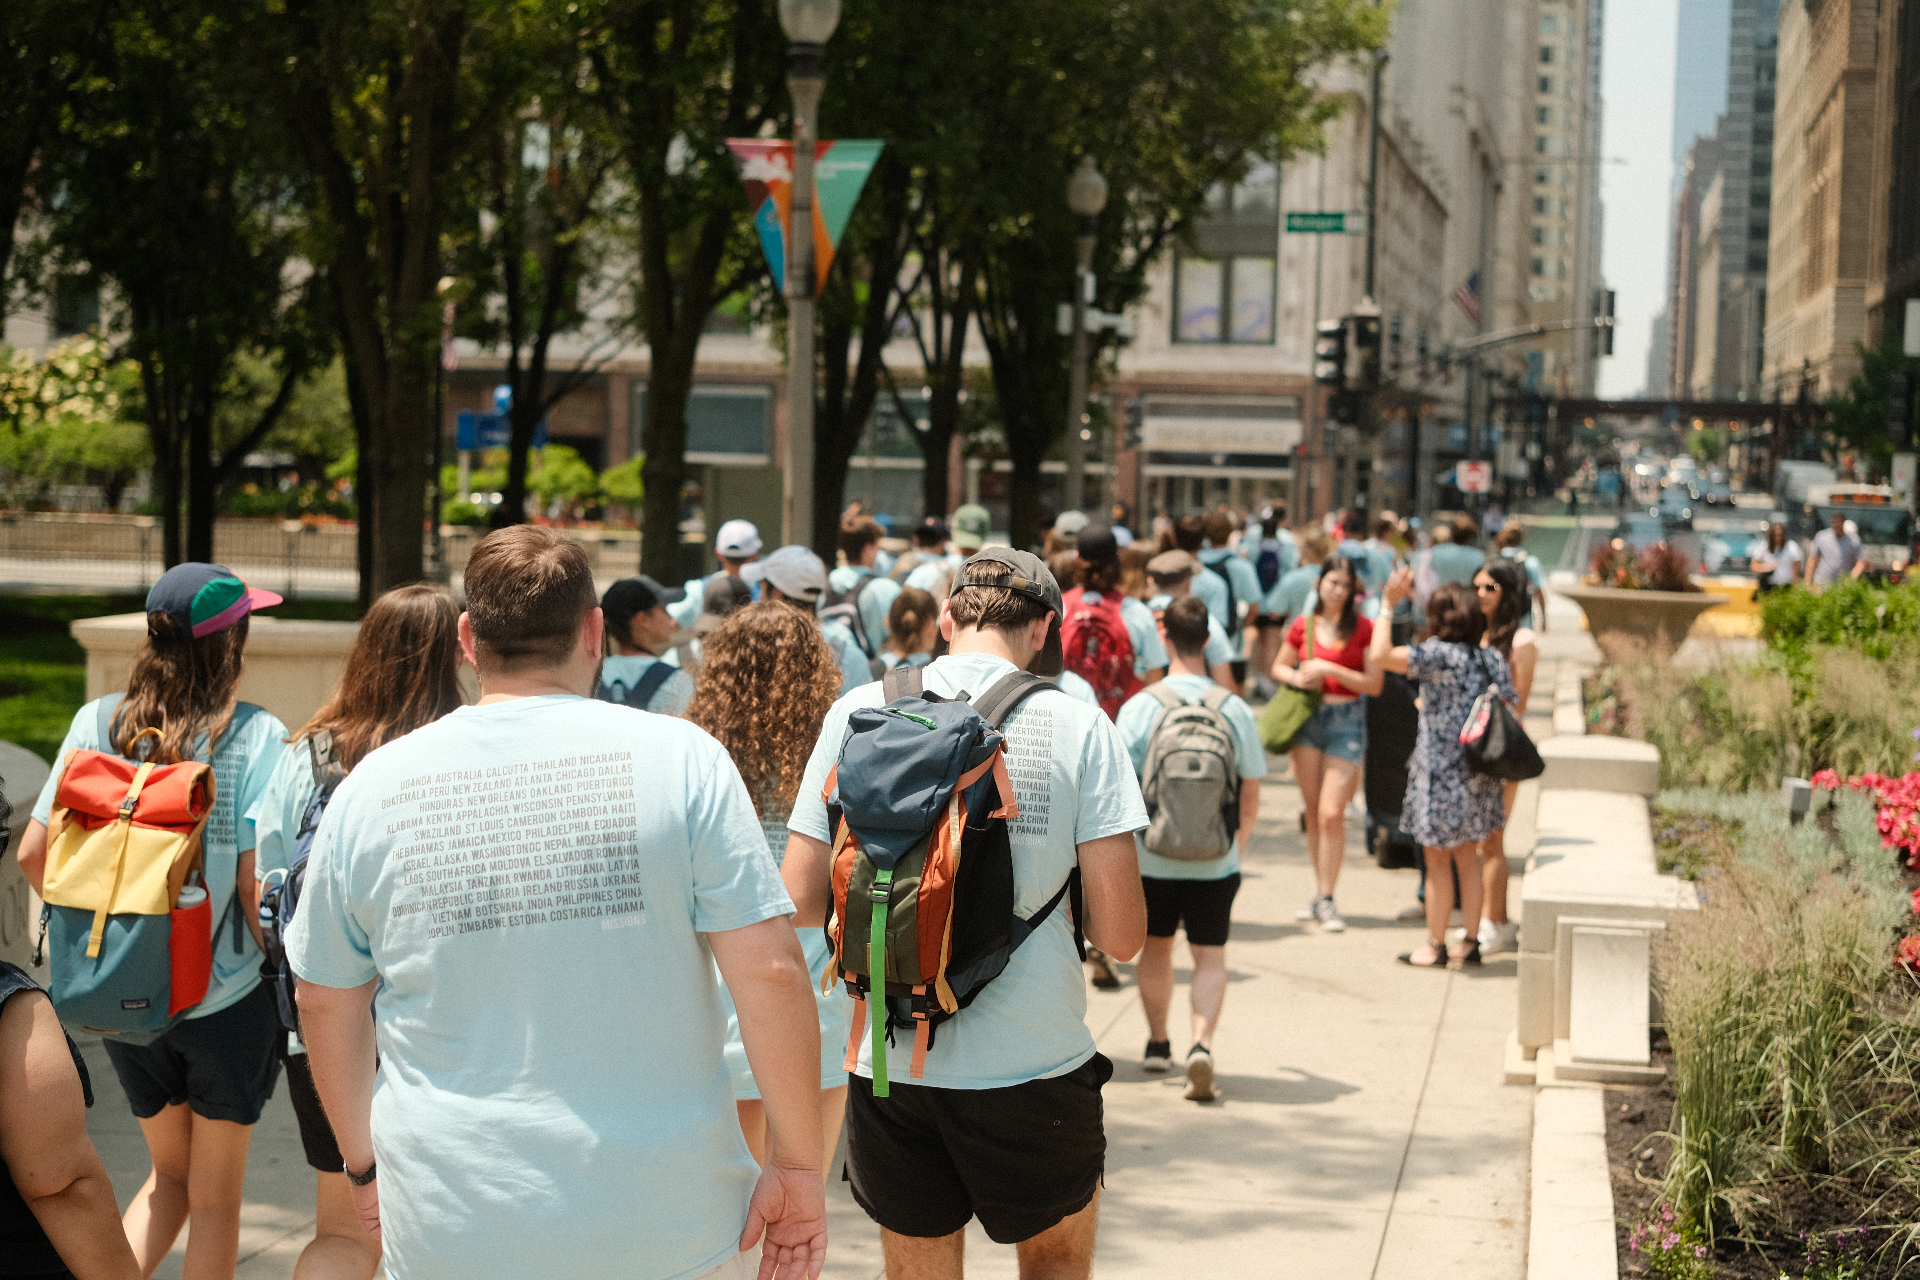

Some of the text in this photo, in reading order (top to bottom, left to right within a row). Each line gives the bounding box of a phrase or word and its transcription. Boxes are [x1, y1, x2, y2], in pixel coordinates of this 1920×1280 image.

[1012, 707, 1052, 718] NICARAGUA
[1025, 717, 1052, 728] DALLAS
[1017, 759, 1051, 770] ECUADOR
[1032, 749, 1052, 759] HAITI
[401, 751, 632, 790] UGANDA AUSTRALIA CALCUTTA THAILAND NICARAGUA
[1007, 769, 1051, 781] OZAMBIQUE
[381, 789, 426, 809] GUATEMALA
[429, 785, 450, 798] PERU
[515, 773, 553, 787] ATLANTA
[556, 767, 595, 781] CHICAGO
[598, 763, 633, 776] DALLAS
[1016, 780, 1051, 792] ROMANIA
[420, 797, 464, 812] HONDURAS
[530, 783, 572, 798] OAKLAND
[1018, 803, 1050, 814] UKRAINE
[1024, 792, 1051, 803] LATVIA
[387, 789, 634, 835] ALABAMA KENYA APPALACHIA WISCONSIN PENNSYLVANIA
[414, 825, 461, 841] SWAZILAND
[507, 812, 557, 828] CAMEROON
[560, 805, 608, 820] CAMBODIA
[611, 802, 636, 814] HAITI
[1026, 814, 1049, 825] CHINA
[448, 836, 486, 850] JAMAICA
[488, 831, 521, 844] MEXICO
[525, 821, 590, 839] PHILADELPHIA
[594, 816, 637, 830] ECUADOR
[1010, 836, 1046, 847] MISSIONS
[1016, 825, 1048, 836] PANAMA
[403, 857, 431, 872] ISRAEL
[433, 851, 468, 867] ALASKA
[544, 837, 573, 851] NEPAL
[576, 830, 638, 846] MOZAMBIQUE
[404, 873, 424, 886] LAOS
[489, 855, 531, 872] MOLDOVA
[596, 844, 638, 859] ROMANIA
[421, 859, 639, 897] MALAYSIA TANZANIA RWANDA LITHUANIA LATVIA
[476, 887, 520, 902] BULGARIA
[523, 881, 562, 896] IRELAND
[564, 877, 599, 891] RUSSIA
[602, 873, 640, 887] UKRAINE
[432, 887, 642, 924] VIETNAM BOTSWANA INDIA PHILIPPINES CHINA
[458, 916, 507, 934] ZIMBABWE
[509, 911, 547, 927] ESTONIA
[605, 901, 645, 915] PANAMA
[601, 914, 646, 930] MISSIONS
